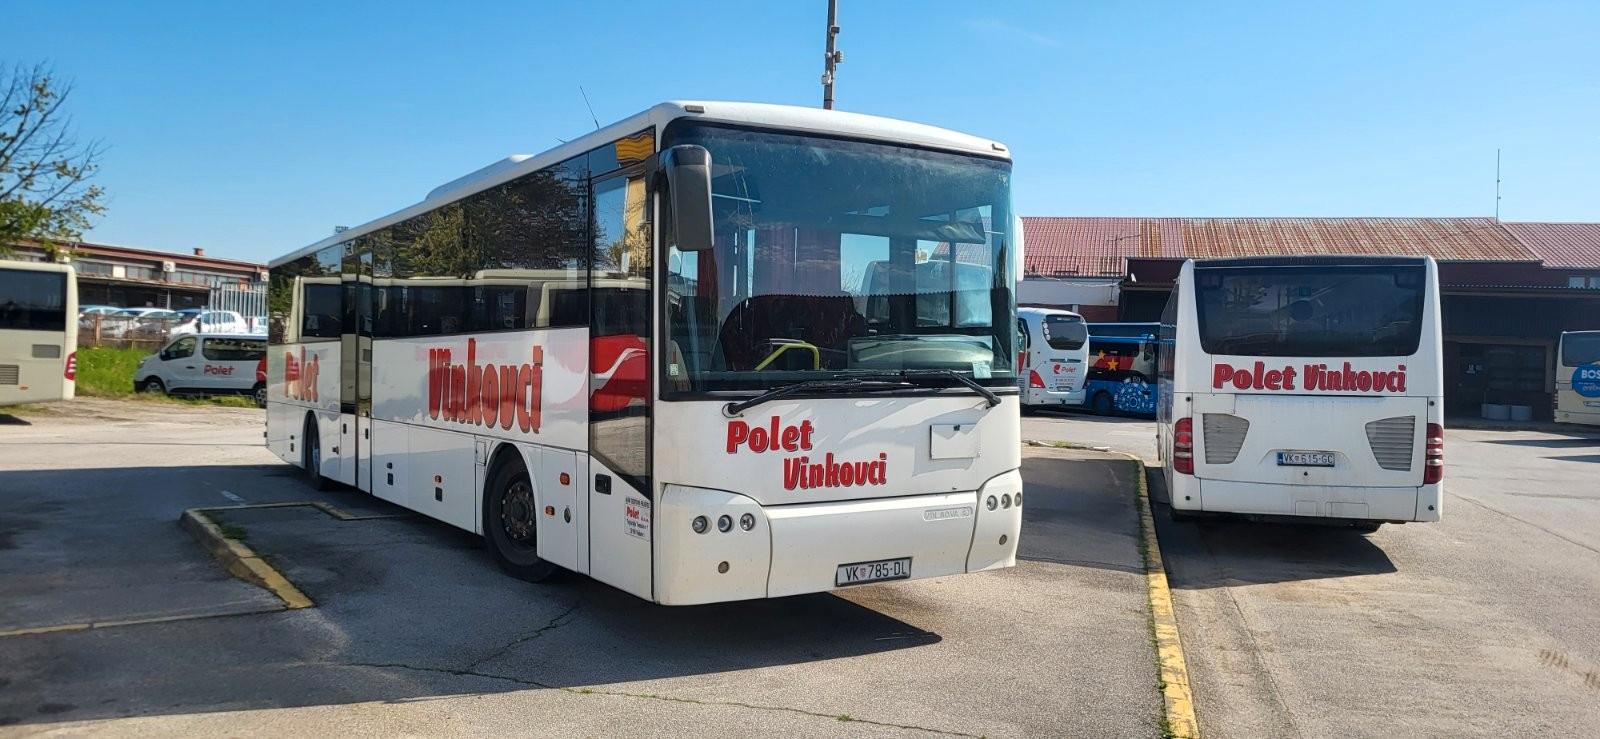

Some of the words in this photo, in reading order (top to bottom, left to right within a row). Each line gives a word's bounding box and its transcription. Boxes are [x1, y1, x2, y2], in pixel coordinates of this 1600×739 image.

[204, 364, 235, 376] Polet
[285, 346, 319, 402] Polet
[429, 338, 543, 434] Vinkovci
[1212, 361, 1297, 391] Polet
[1303, 362, 1406, 392] Vinkovci
[726, 416, 814, 454] Polet
[783, 453, 887, 491] Vinkovci
[845, 567, 860, 581] VK
[867, 561, 907, 579] 785-DL
